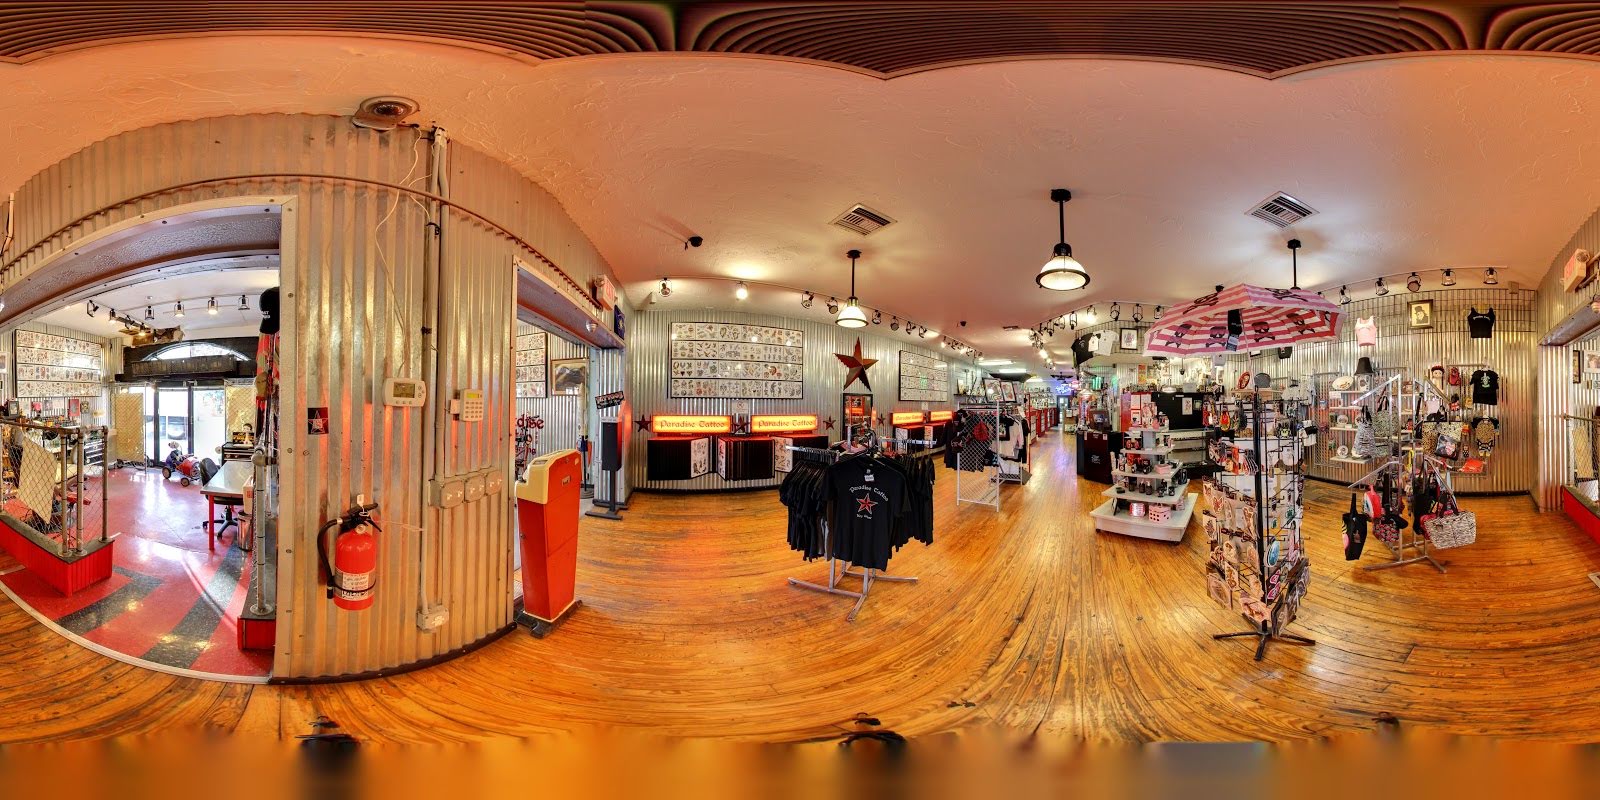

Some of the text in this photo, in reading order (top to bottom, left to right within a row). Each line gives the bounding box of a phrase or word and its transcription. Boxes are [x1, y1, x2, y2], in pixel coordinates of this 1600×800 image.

[516, 414, 544, 429] dise
[660, 420, 725, 429] Paradise Tattoo
[758, 419, 813, 428] Paradise Tattoo
[849, 484, 889, 502] Paradise Tattoo
